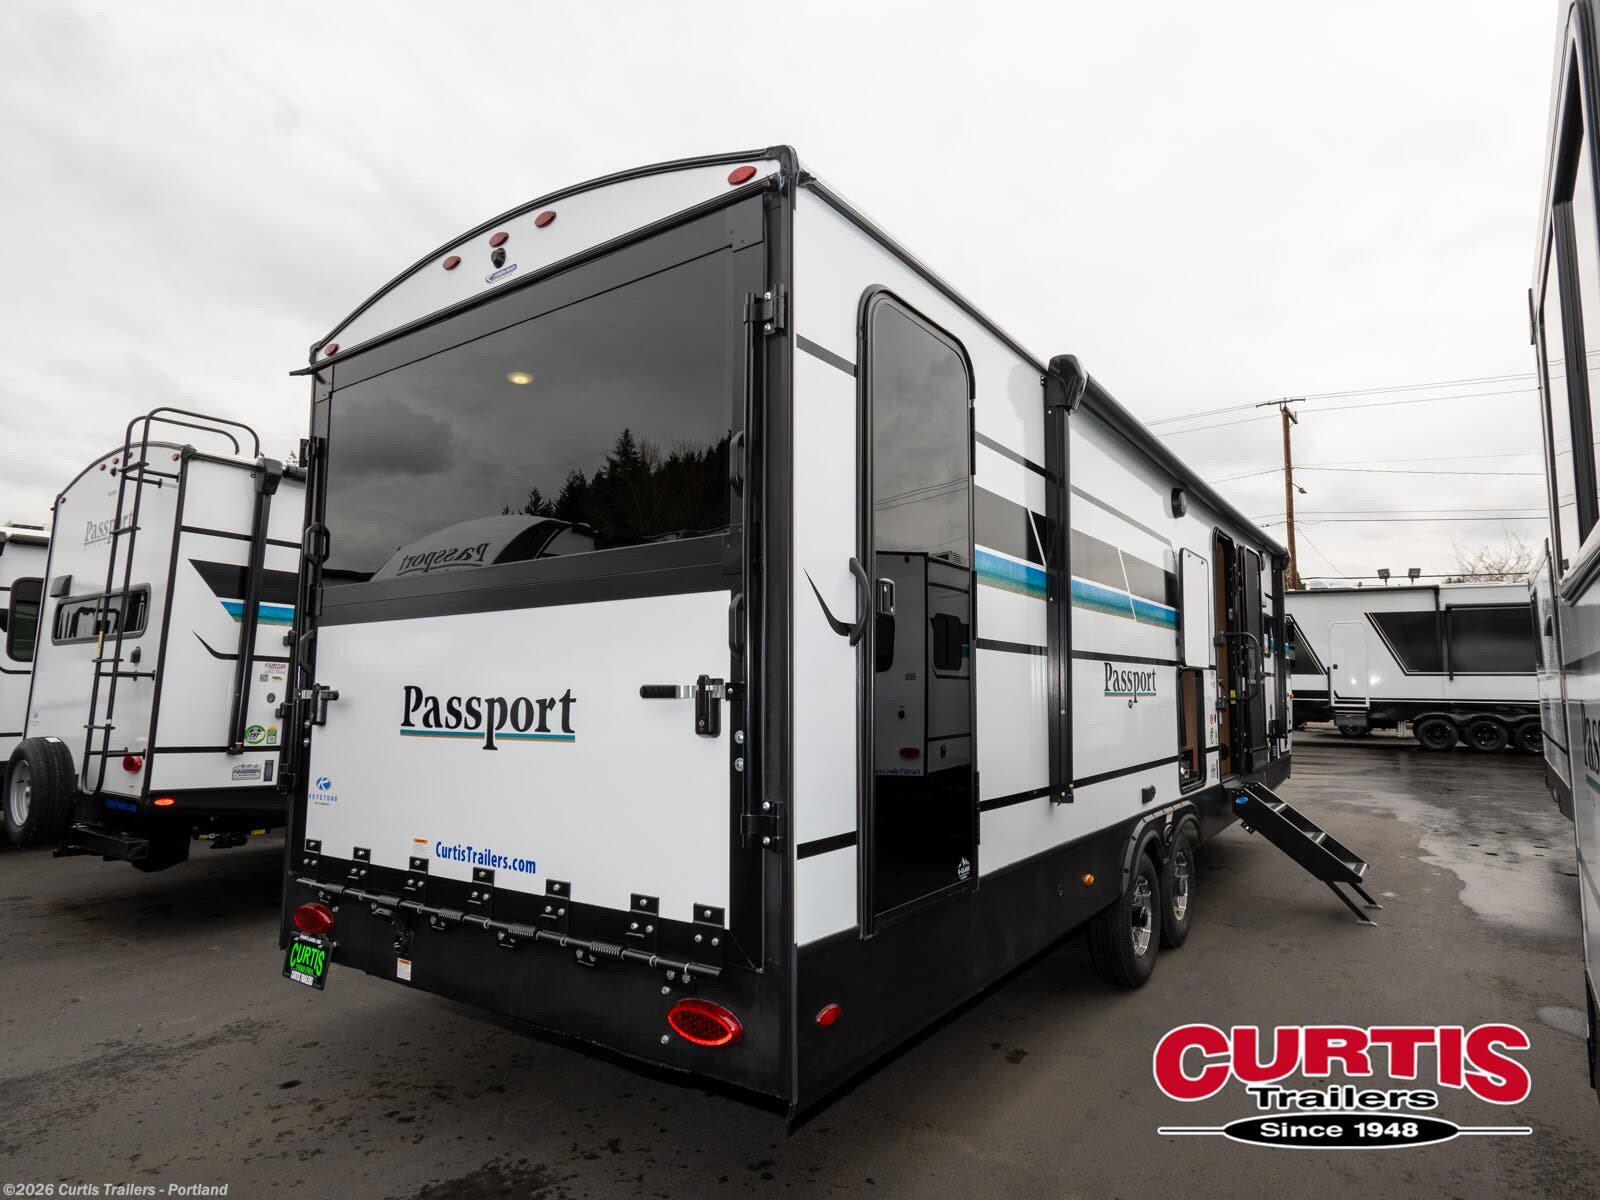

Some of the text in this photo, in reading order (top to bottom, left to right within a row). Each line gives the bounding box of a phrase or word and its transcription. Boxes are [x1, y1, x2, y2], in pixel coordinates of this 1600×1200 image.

[1103, 662, 1157, 703] Passport
[400, 685, 577, 750] Passport
[435, 841, 536, 875] CurtisTrailers.com
[289, 942, 326, 977] CURTIS
